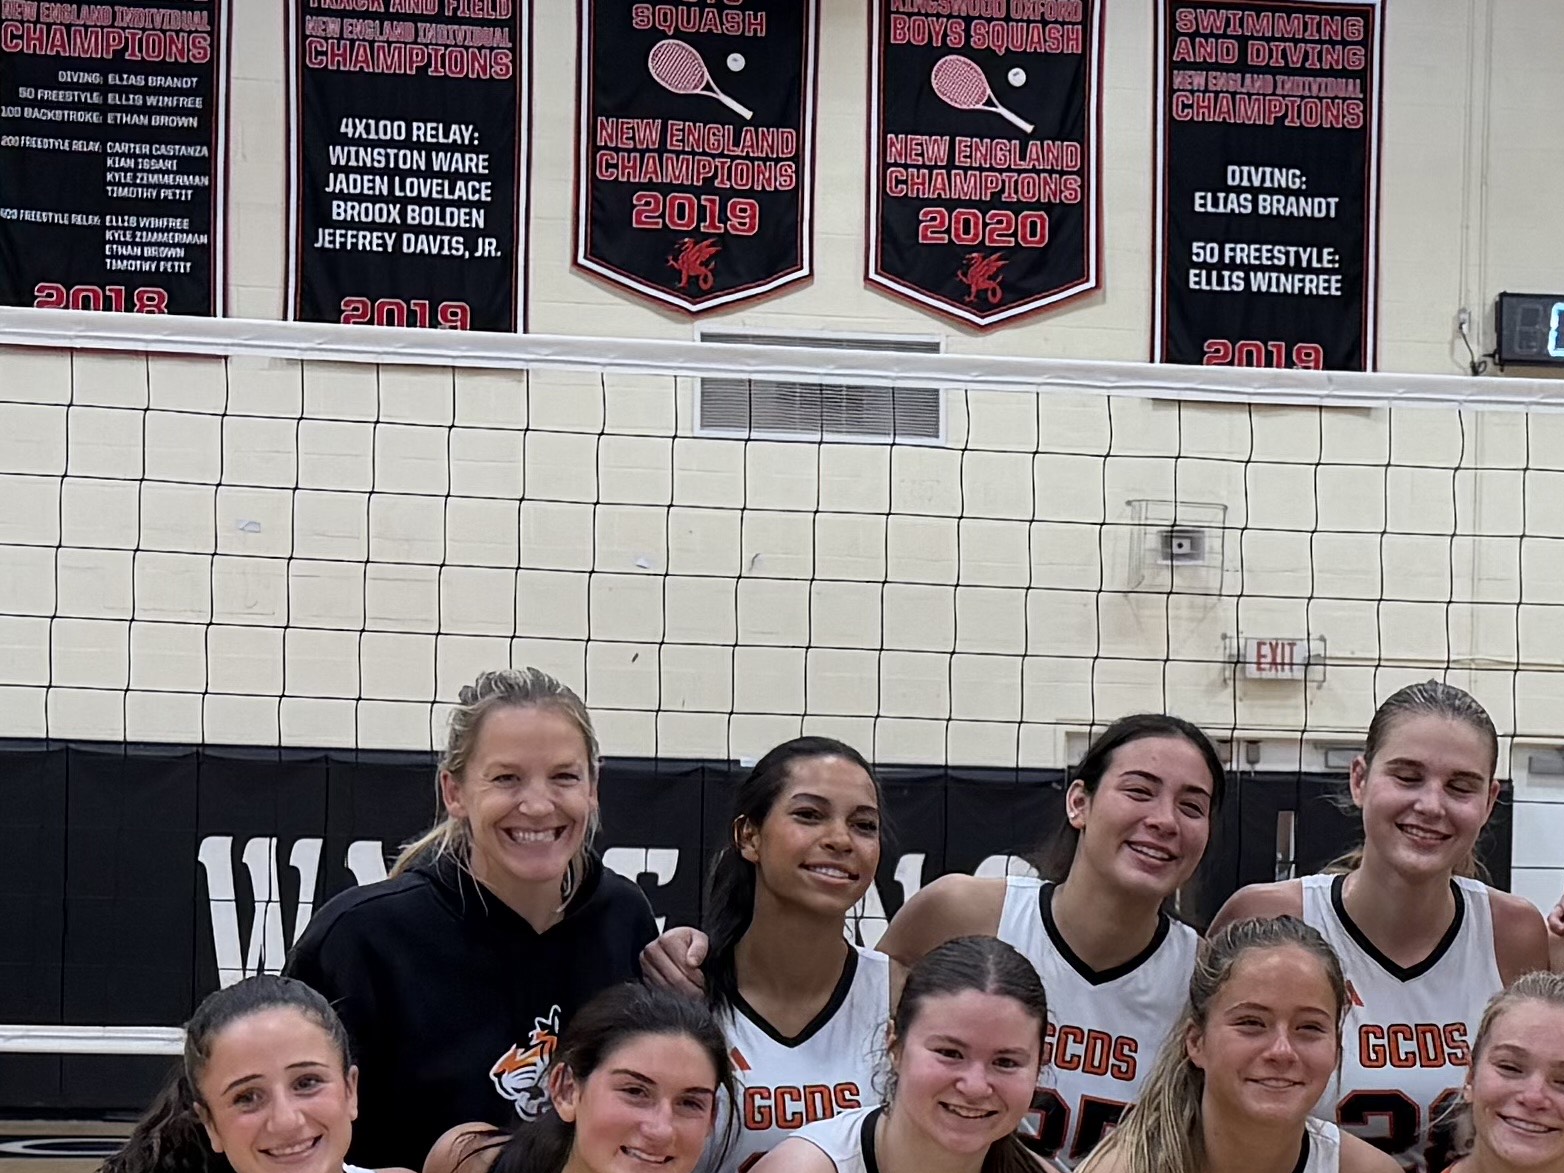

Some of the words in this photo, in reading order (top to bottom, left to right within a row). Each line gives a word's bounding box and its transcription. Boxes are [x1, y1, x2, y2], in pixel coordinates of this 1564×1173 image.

[1, 0, 37, 20] NEW
[40, 2, 112, 26] ENGLAND
[445, 0, 512, 19] FIELD
[632, 3, 767, 37] SQUASH
[1010, 0, 1083, 22] OXFORD
[1175, 8, 1364, 41] SWIMMING
[2, 21, 210, 63] CHAMPIONS
[305, 15, 341, 37] NEW
[343, 18, 415, 42] ENGLAND
[890, 14, 965, 48] BOYS
[970, 19, 1082, 56] SQUASH
[306, 37, 513, 79] CHAMPIONS
[1173, 37, 1239, 64] AND
[1247, 40, 1365, 70] DIVING
[58, 71, 103, 84] DIVING:
[108, 73, 145, 86] ELIAS
[1173, 70, 1206, 91] NEW
[1208, 71, 1274, 95] ENGLAND
[107, 113, 149, 126] ETHAN
[151, 115, 198, 128] BROWN
[1172, 91, 1364, 129] CHAMPIONS
[339, 118, 406, 140] 4X100
[412, 122, 479, 145] RELAY:
[597, 117, 661, 149] NEW
[667, 120, 796, 158] ENGLAND
[329, 145, 426, 171] WINSTON
[432, 151, 489, 174] WARE
[886, 134, 950, 166] NEW
[955, 136, 1081, 171] ENGLAND
[596, 150, 796, 191] CHAMPIONS
[886, 167, 1082, 204] CHAMPIONS
[1227, 165, 1306, 190] DIVING:
[325, 173, 388, 195] JADEN
[394, 176, 492, 202] LOVELACE
[332, 201, 401, 224] BROOX
[407, 205, 485, 229] BOLDEN
[632, 191, 759, 236] 2019
[1194, 192, 1252, 214] ELIAS
[1258, 194, 1339, 218] BRANDT
[314, 228, 398, 252] JEFFREY
[402, 233, 470, 259] DAVIS,
[474, 238, 502, 258] JR.
[918, 207, 1049, 248] 2020
[1191, 242, 1219, 264] 50
[1224, 243, 1340, 269] FREESTYLE:
[34, 282, 168, 314] 2018
[1189, 269, 1245, 292] ELLIS
[1250, 271, 1342, 296] WINFREE
[340, 296, 471, 331] 2019
[1203, 339, 1323, 371] 2019
[1256, 641, 1297, 673] EXIT
[1358, 1022, 1472, 1069] GCDS
[743, 1082, 862, 1130] GCDS
